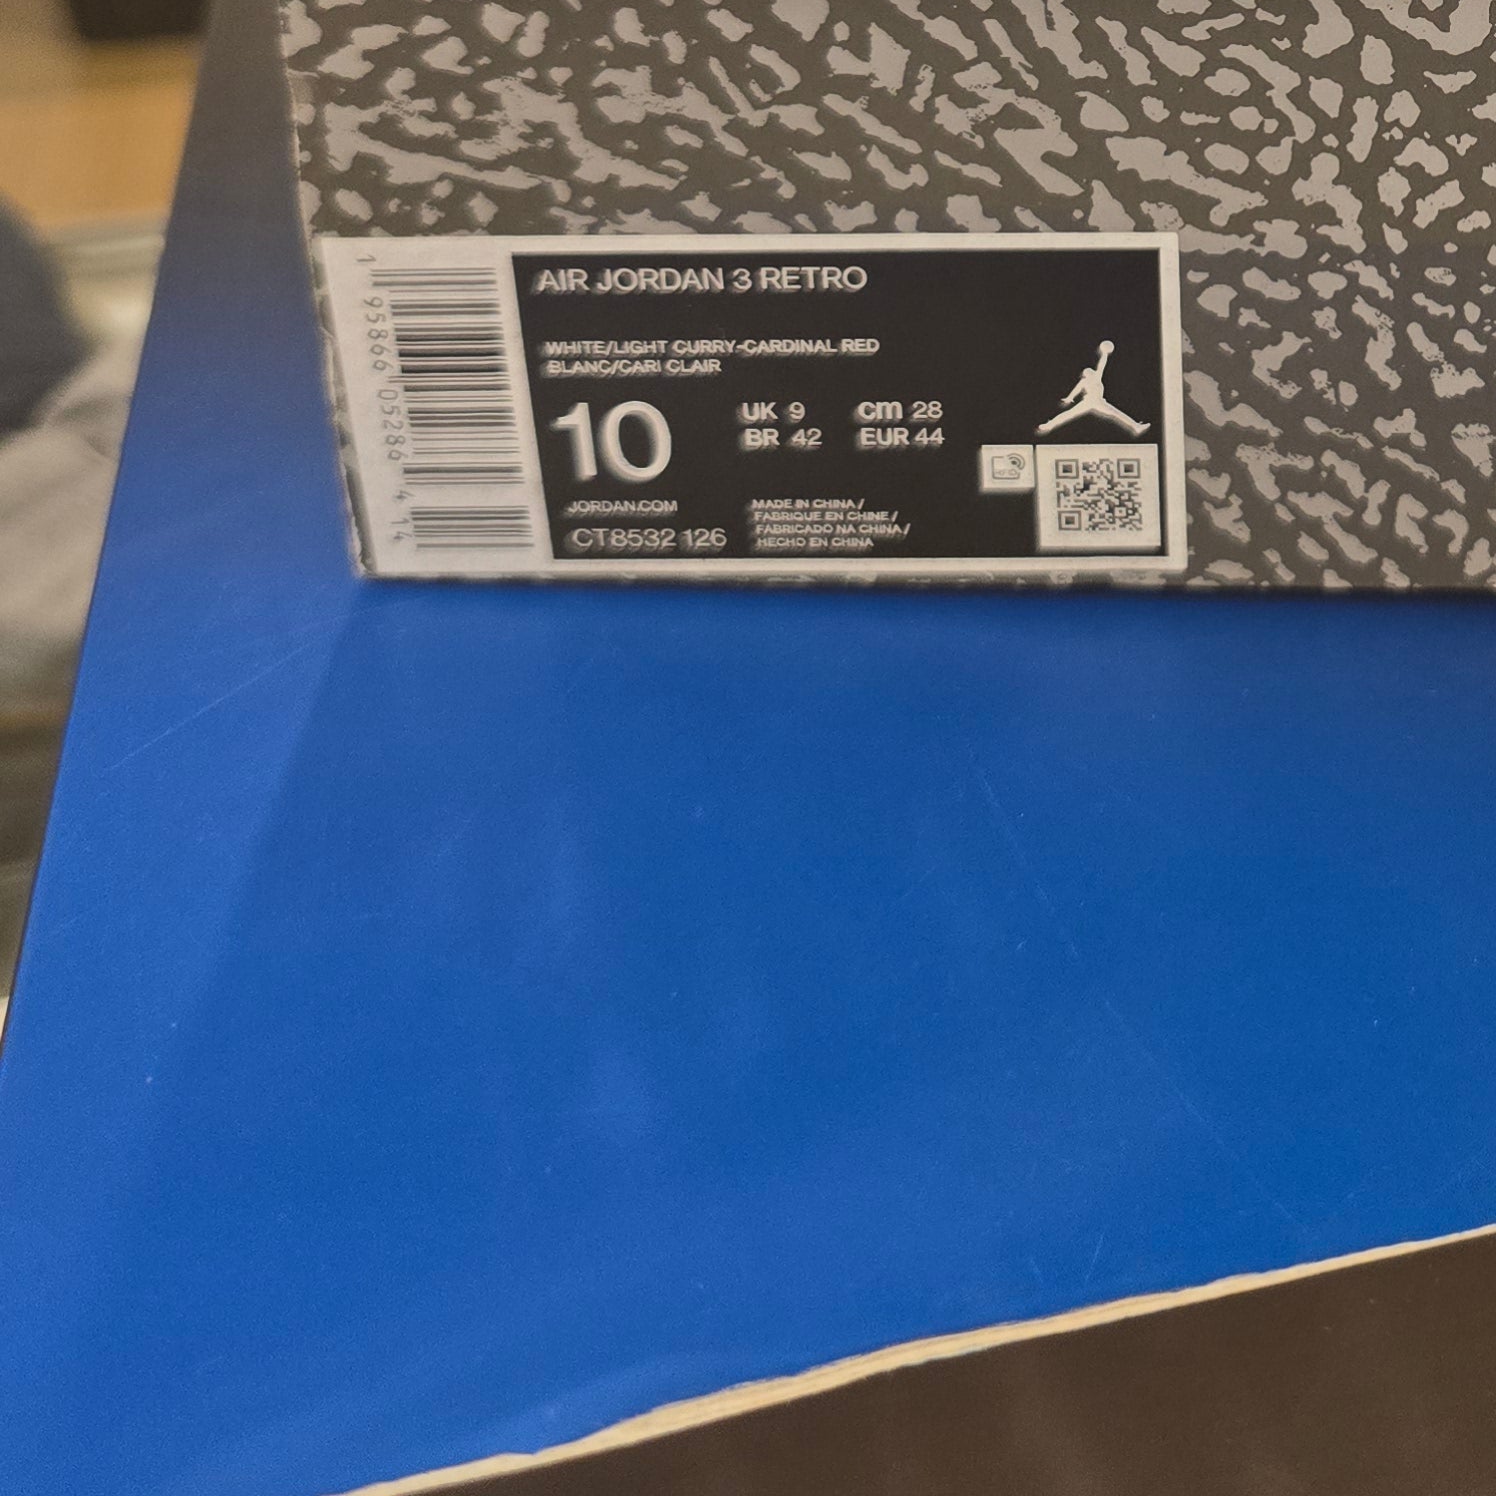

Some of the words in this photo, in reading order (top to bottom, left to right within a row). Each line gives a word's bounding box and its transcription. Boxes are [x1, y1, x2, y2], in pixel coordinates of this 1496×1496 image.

[537, 268, 590, 292] AIR
[596, 267, 725, 292] JORDAN
[732, 267, 752, 291] 3
[759, 265, 868, 290] RETRO
[544, 340, 668, 357] WHITE/LIGHT
[673, 338, 837, 355] CURRY-CARDINAL
[842, 337, 881, 354] RED
[547, 359, 661, 375] BLANC/CARI
[666, 358, 722, 373] CLAIR
[741, 401, 778, 421] UK
[788, 401, 806, 420] 9
[857, 401, 903, 420] cm
[912, 400, 944, 420] 28
[551, 400, 673, 482] 10
[742, 428, 780, 447] BR
[791, 427, 823, 446] 42
[859, 427, 910, 446] EUR
[914, 427, 946, 446] 44
[568, 499, 678, 514] JORDAN.COM
[751, 499, 793, 509] MADE
[795, 499, 810, 509] IN
[813, 499, 856, 509] CHINA
[825, 511, 844, 521] EN
[847, 511, 890, 521] CHINE
[572, 528, 677, 549] CT8532
[682, 527, 728, 547] 126
[756, 524, 833, 535] FABRICADO
[836, 524, 857, 534] NA
[859, 524, 902, 535] CHINA
[757, 537, 807, 548] HECHO
[809, 537, 829, 548] EN
[831, 537, 874, 547] CHINA
